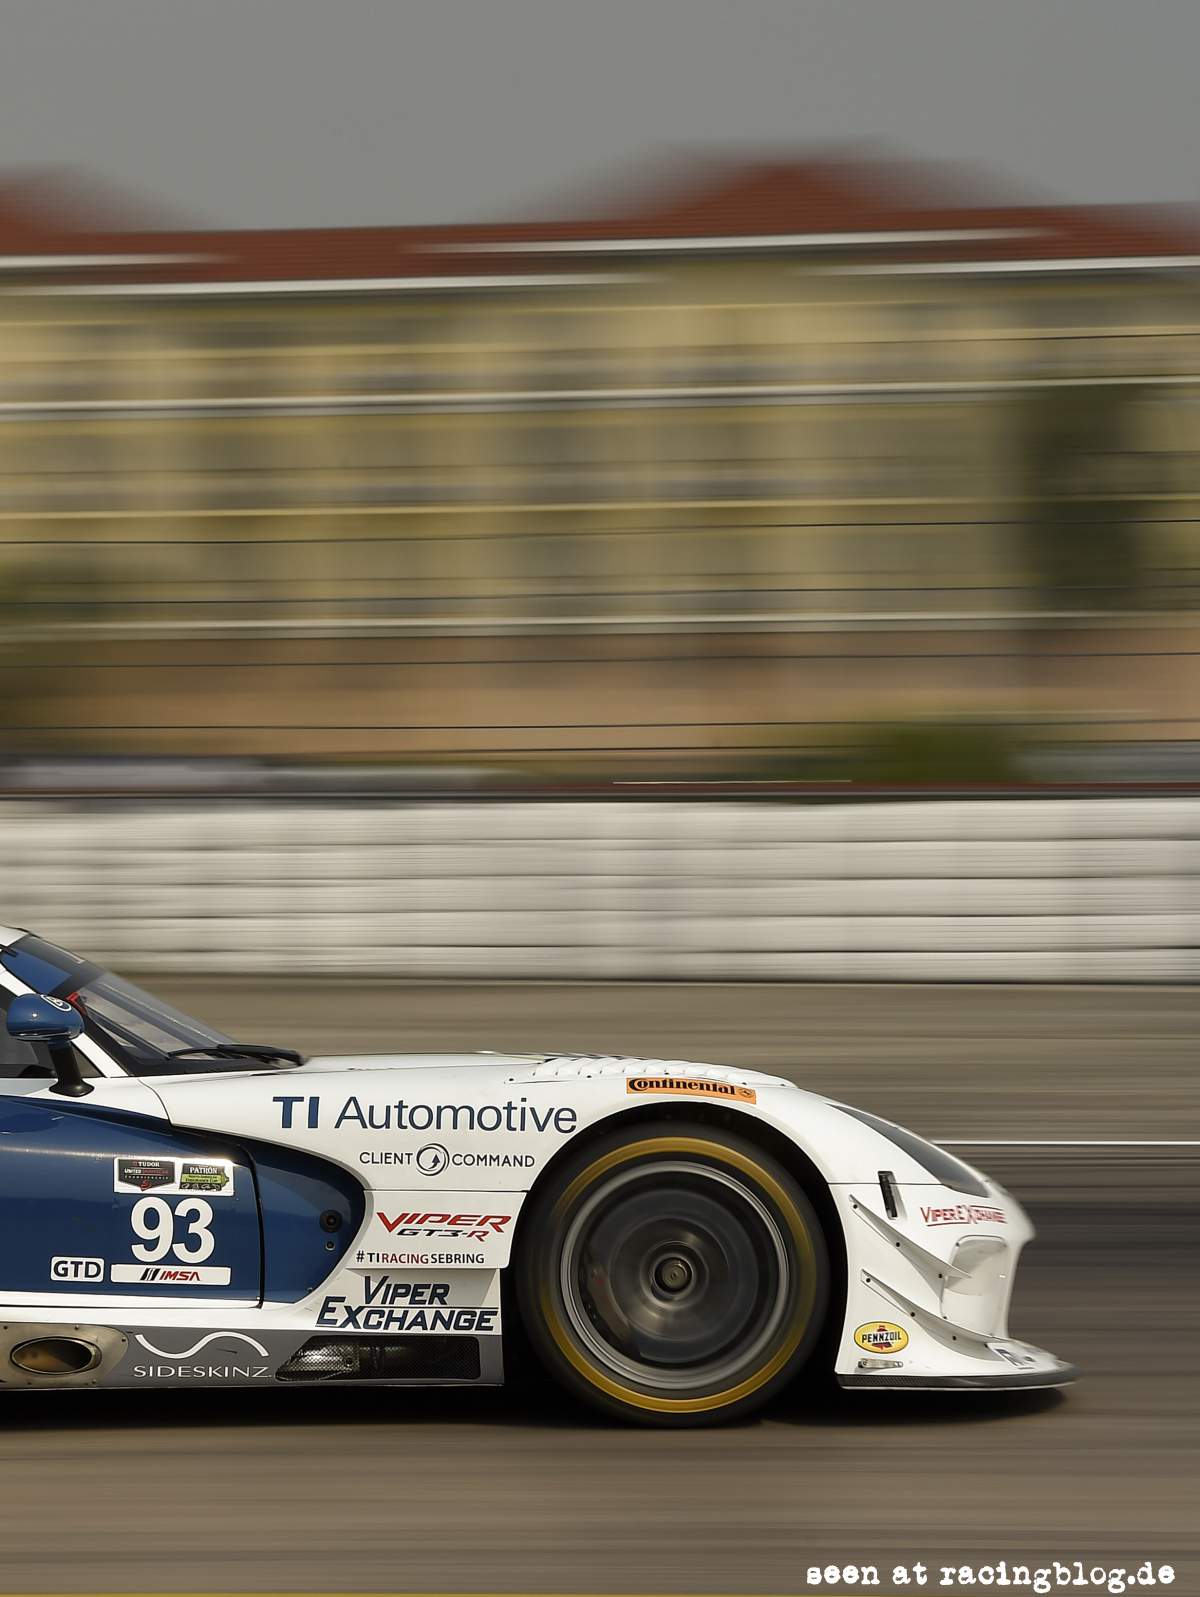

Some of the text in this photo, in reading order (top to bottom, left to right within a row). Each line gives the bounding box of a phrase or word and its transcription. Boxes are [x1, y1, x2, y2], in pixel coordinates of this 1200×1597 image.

[629, 1078, 736, 1095] Continental
[272, 1096, 577, 1133] TI Automotive
[359, 1152, 535, 1167] CLIENT COMMAND
[130, 1196, 215, 1264] 93
[377, 1212, 512, 1233] VIPER
[397, 1228, 489, 1242] GT3-R
[53, 1260, 101, 1278] GTD
[159, 1270, 201, 1281] IMSA
[364, 1276, 450, 1305] VIPER
[316, 1296, 498, 1331] EXCHANGE
[861, 1331, 902, 1343] PENNZOIL
[133, 1365, 269, 1378] SIDESKINZ
